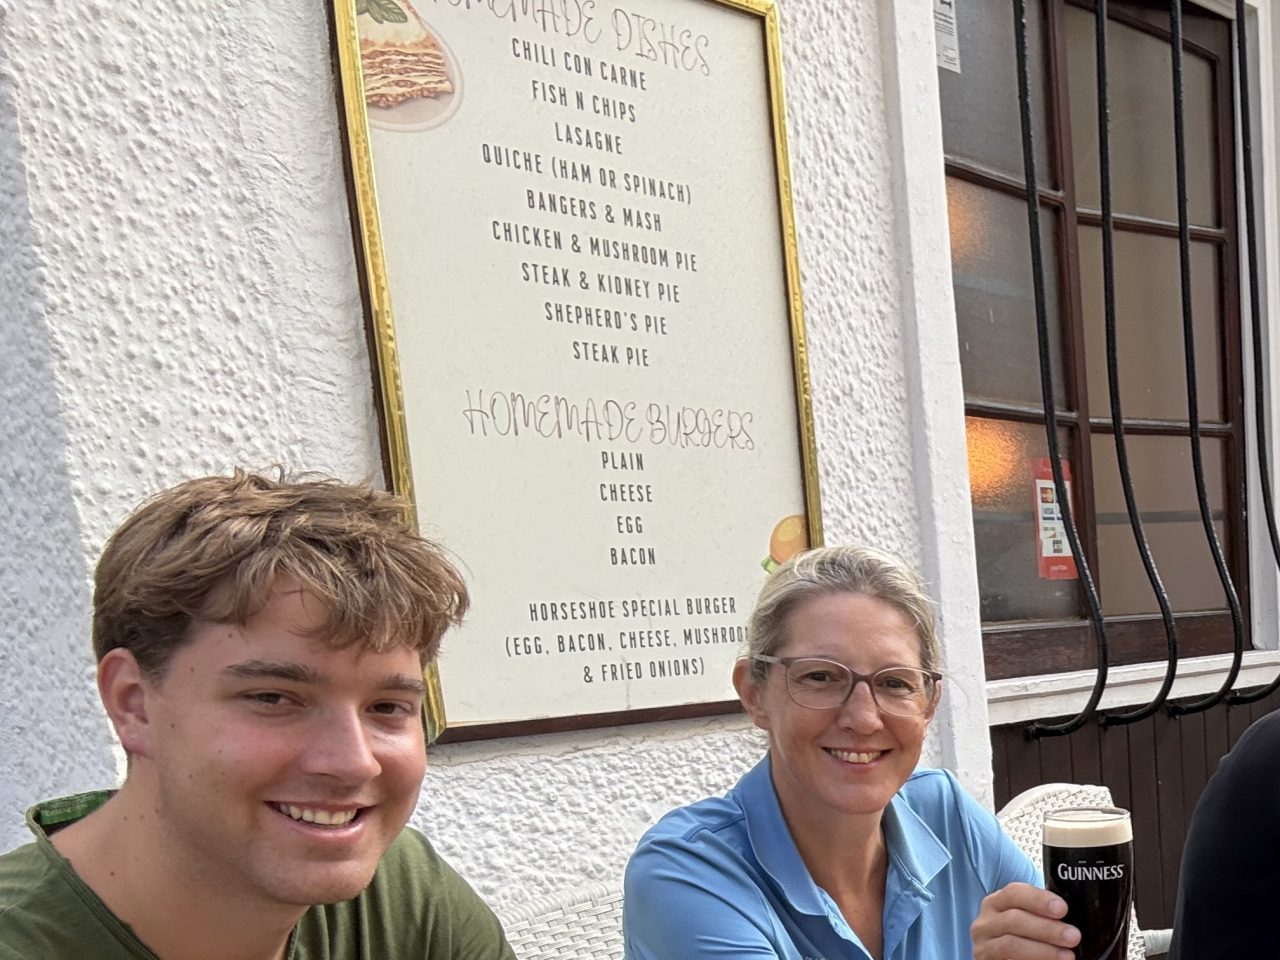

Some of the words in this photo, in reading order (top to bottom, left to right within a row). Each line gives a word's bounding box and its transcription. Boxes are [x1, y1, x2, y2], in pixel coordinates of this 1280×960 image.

[611, 8, 711, 77] DISHES
[511, 37, 556, 68] CHILI
[563, 51, 593, 77] CON
[599, 61, 647, 91] CARNE
[531, 79, 568, 107] FISH
[575, 90, 585, 111] N
[592, 94, 636, 123] CHIPS
[554, 121, 623, 155] LASAGNE
[481, 143, 543, 175] QUICHE
[551, 156, 592, 184] (HAM
[598, 167, 617, 189] OR
[623, 172, 691, 205] SPINACH)
[526, 188, 597, 221] BANGERS
[604, 204, 616, 224] &
[622, 207, 662, 233] MASH
[491, 220, 563, 251] CHICKEN
[571, 233, 582, 254] &
[589, 236, 669, 268] MUSHROOM
[675, 251, 698, 273] PIE
[521, 262, 571, 288] STEAK
[579, 270, 590, 290] &
[597, 273, 650, 299] KIDNEY
[657, 282, 680, 304] PIE
[544, 301, 638, 332] SHEPHERD'S
[644, 314, 668, 336] PIE
[572, 340, 620, 364] STEAK
[626, 346, 649, 367] PIE
[462, 388, 644, 444] HOMEMADE
[646, 402, 755, 451] BURGERS
[601, 450, 644, 471] PLAIN
[599, 483, 653, 503] CHEESE
[616, 515, 643, 534] EGG
[609, 547, 656, 566] BACON
[528, 600, 616, 622] HORSESHOE
[621, 598, 681, 618] SPECIAL
[685, 596, 737, 616] BURGER
[505, 635, 550, 658] (EGG,
[556, 632, 613, 653] BACON,
[619, 629, 677, 650] CHEESE,
[583, 665, 594, 684] &
[601, 661, 643, 682] FRIED
[649, 656, 705, 679] ONIONS)
[1058, 862, 1125, 881] GUINNESS
